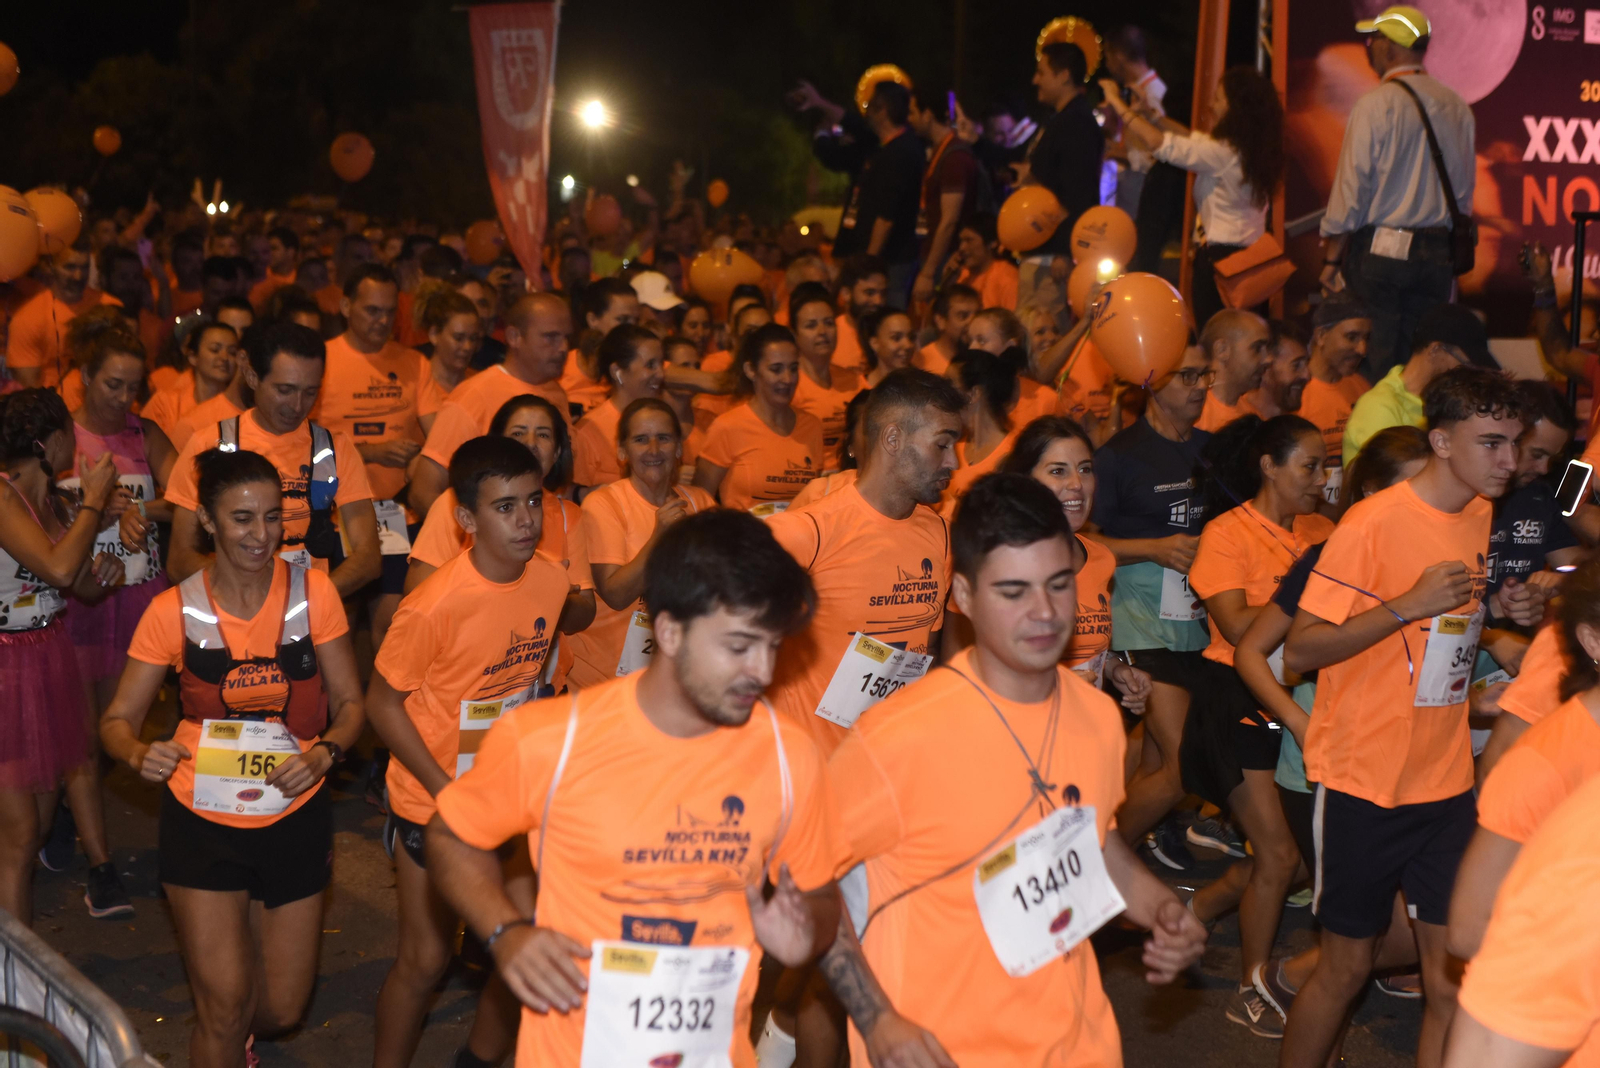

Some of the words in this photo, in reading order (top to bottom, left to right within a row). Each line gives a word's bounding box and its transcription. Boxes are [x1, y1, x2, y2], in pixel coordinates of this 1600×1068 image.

[1512, 519, 1541, 537] 365
[97, 542, 132, 557] 703
[892, 581, 939, 593] NOCTURNA
[869, 594, 915, 607] SEVILLA
[916, 591, 938, 604] KH7
[506, 639, 549, 657] NOCTURNA
[483, 655, 522, 675] SEVILLA
[524, 648, 548, 662] KH7
[665, 831, 752, 843] NOCTURNA
[622, 849, 704, 864] SEVILLA
[708, 847, 749, 863] KH7
[1012, 848, 1082, 912] 13410
[629, 995, 715, 1031] 12332
